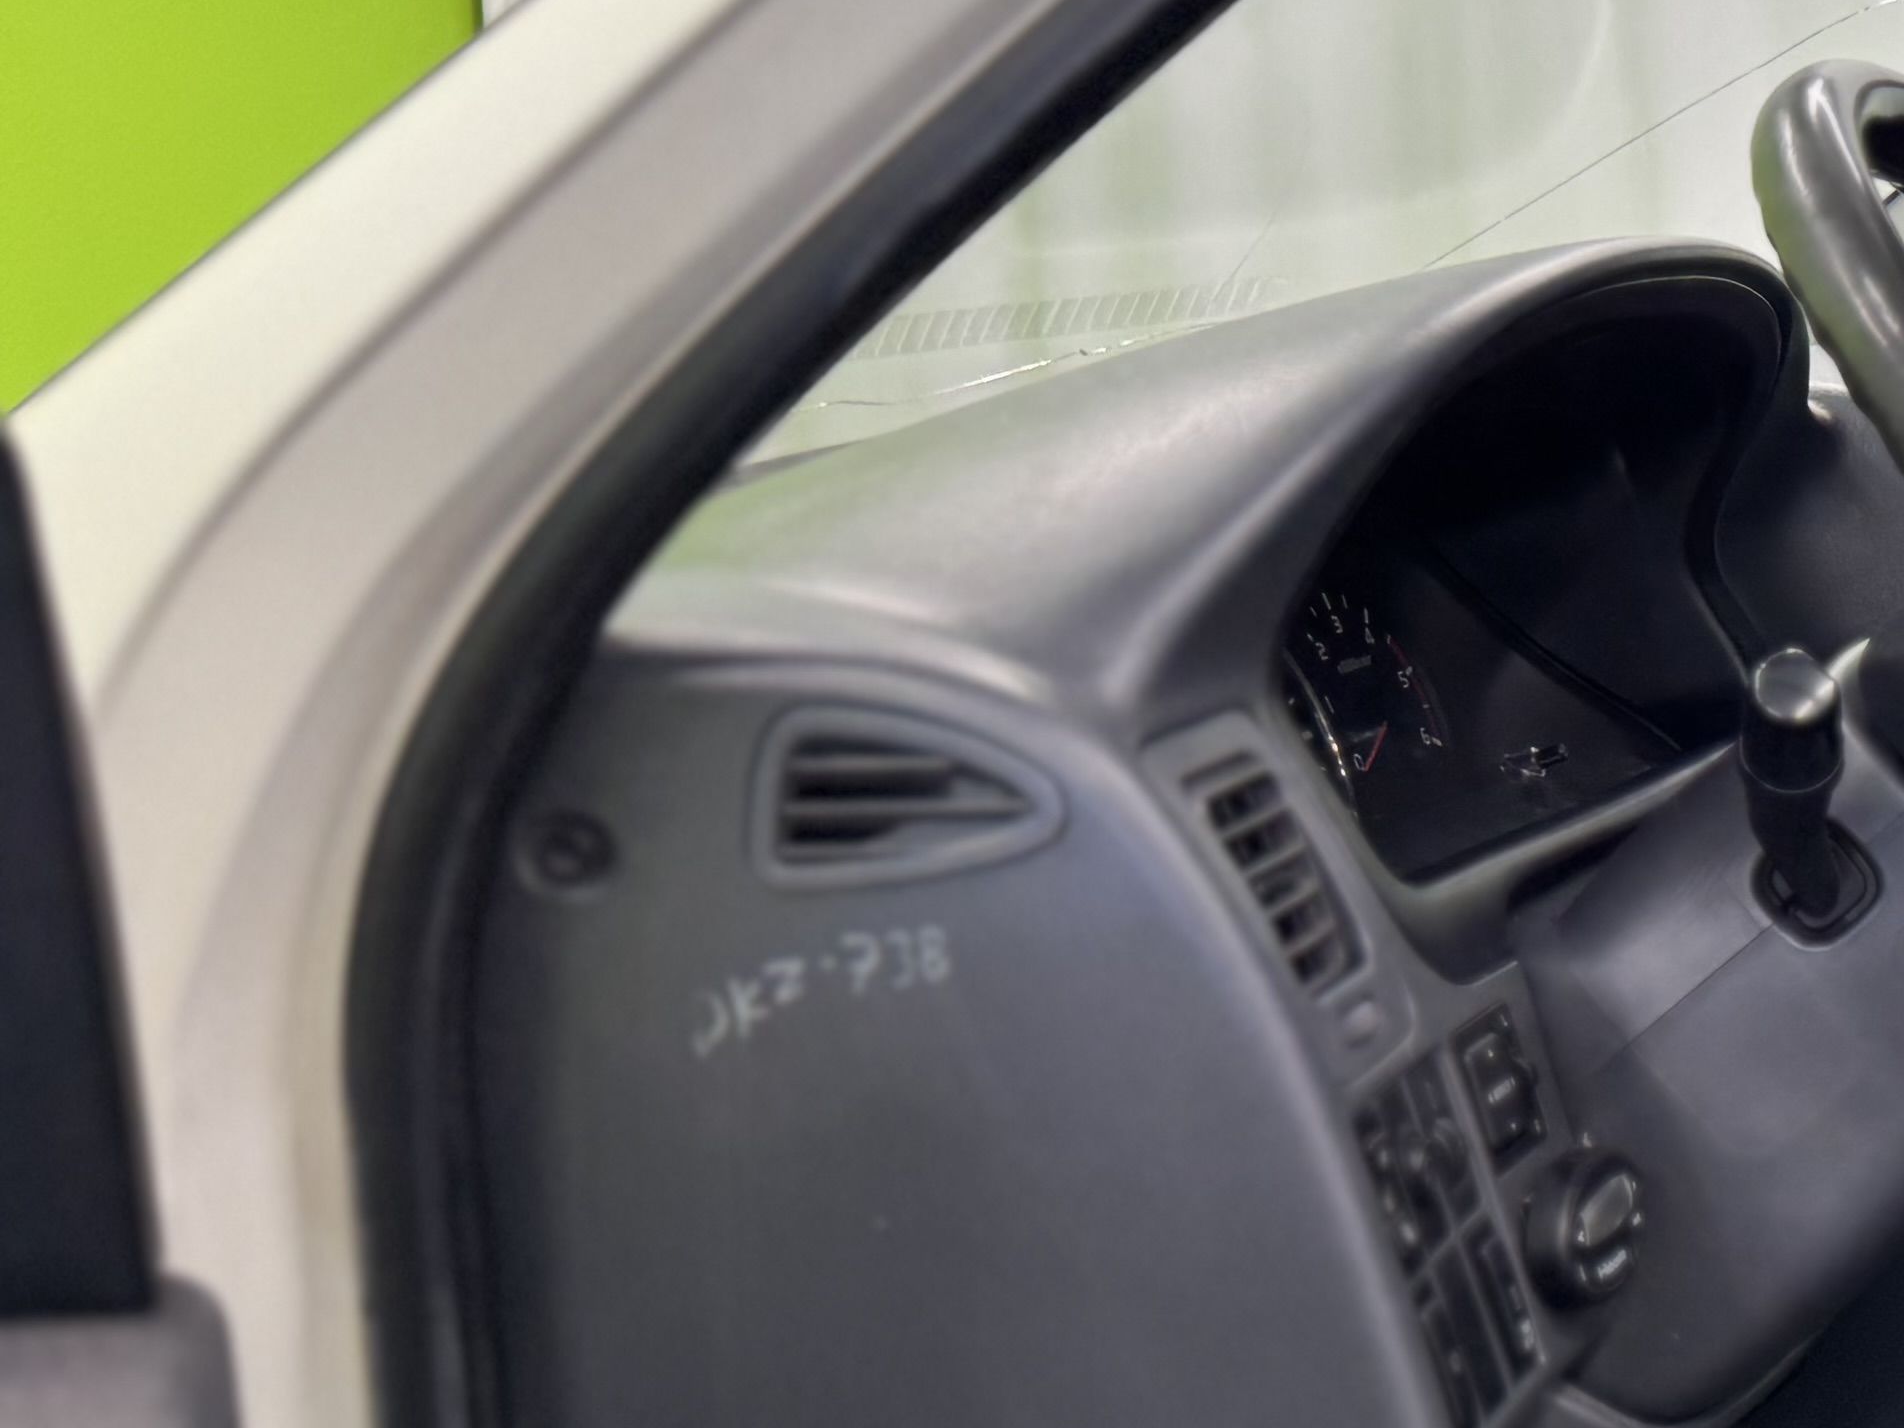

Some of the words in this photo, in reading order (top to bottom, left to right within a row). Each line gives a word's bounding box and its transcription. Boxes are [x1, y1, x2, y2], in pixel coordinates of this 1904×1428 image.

[1330, 615, 1343, 634] 3
[1315, 642, 1329, 661] 2
[1397, 670, 1410, 689] 5
